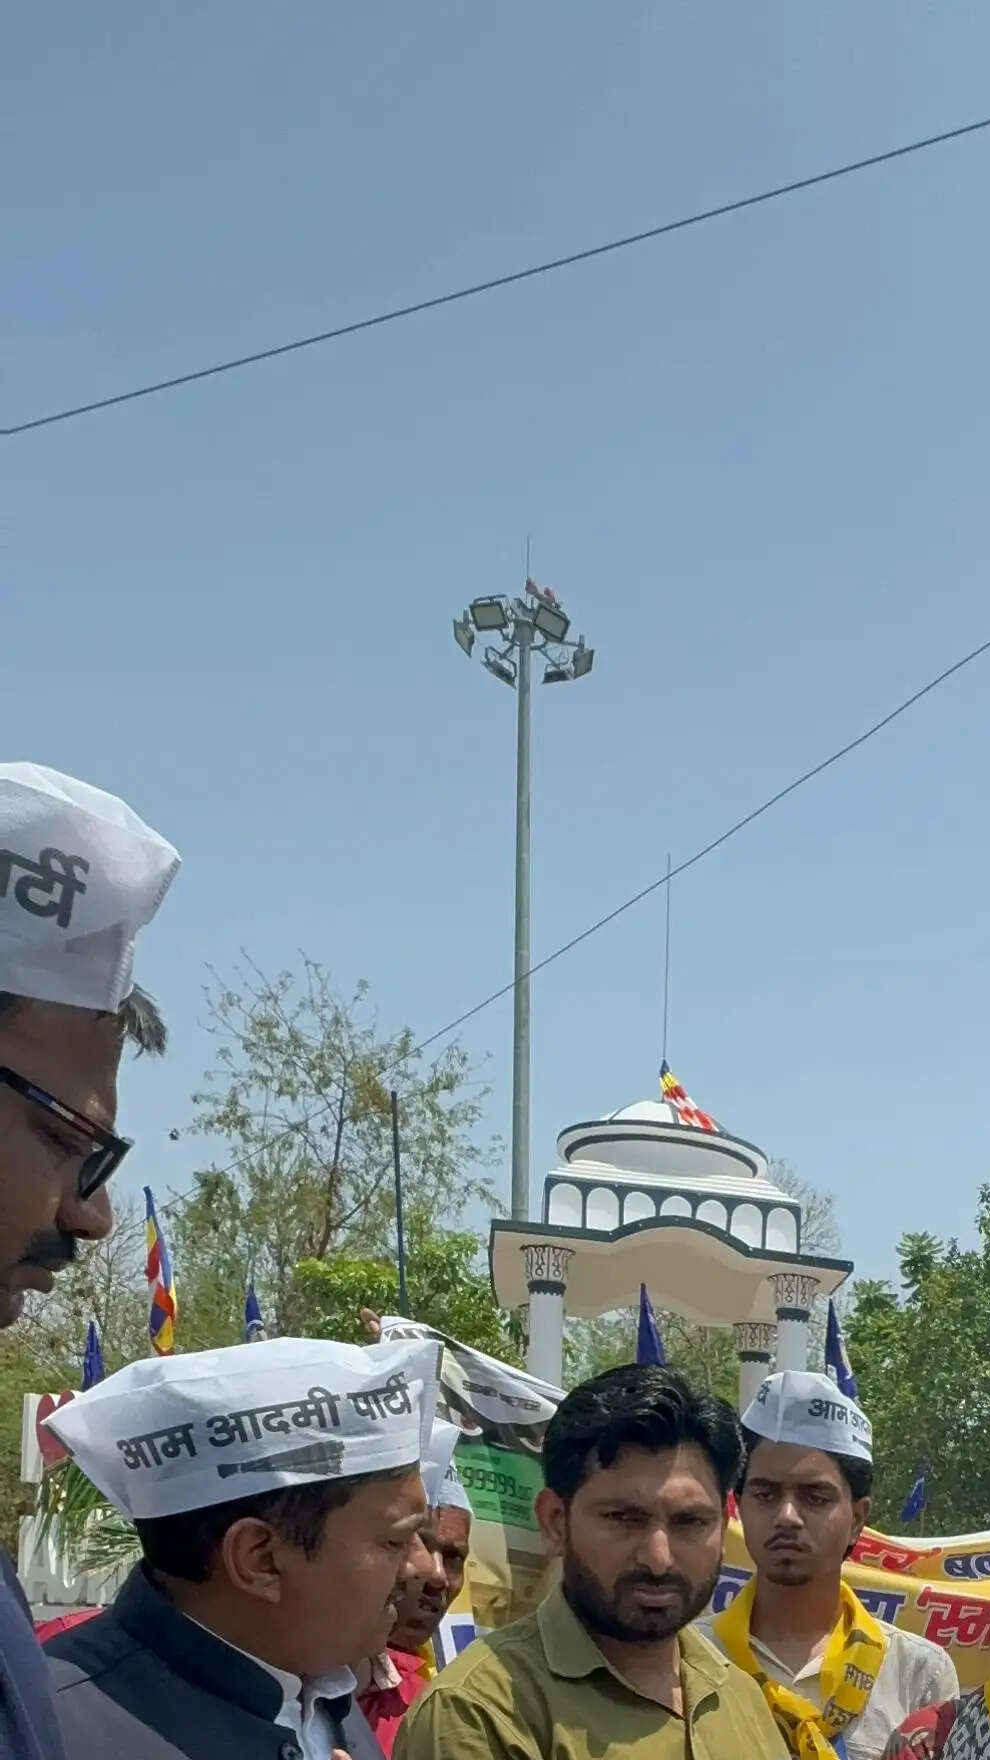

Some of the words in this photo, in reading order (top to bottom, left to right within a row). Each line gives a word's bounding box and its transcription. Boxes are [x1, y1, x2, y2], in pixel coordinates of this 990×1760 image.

[0, 847, 90, 929] ार्टी
[116, 1422, 197, 1471] आम
[205, 1386, 340, 1448] आदमी
[347, 1371, 415, 1421] पार्टी
[808, 1398, 849, 1425] आम
